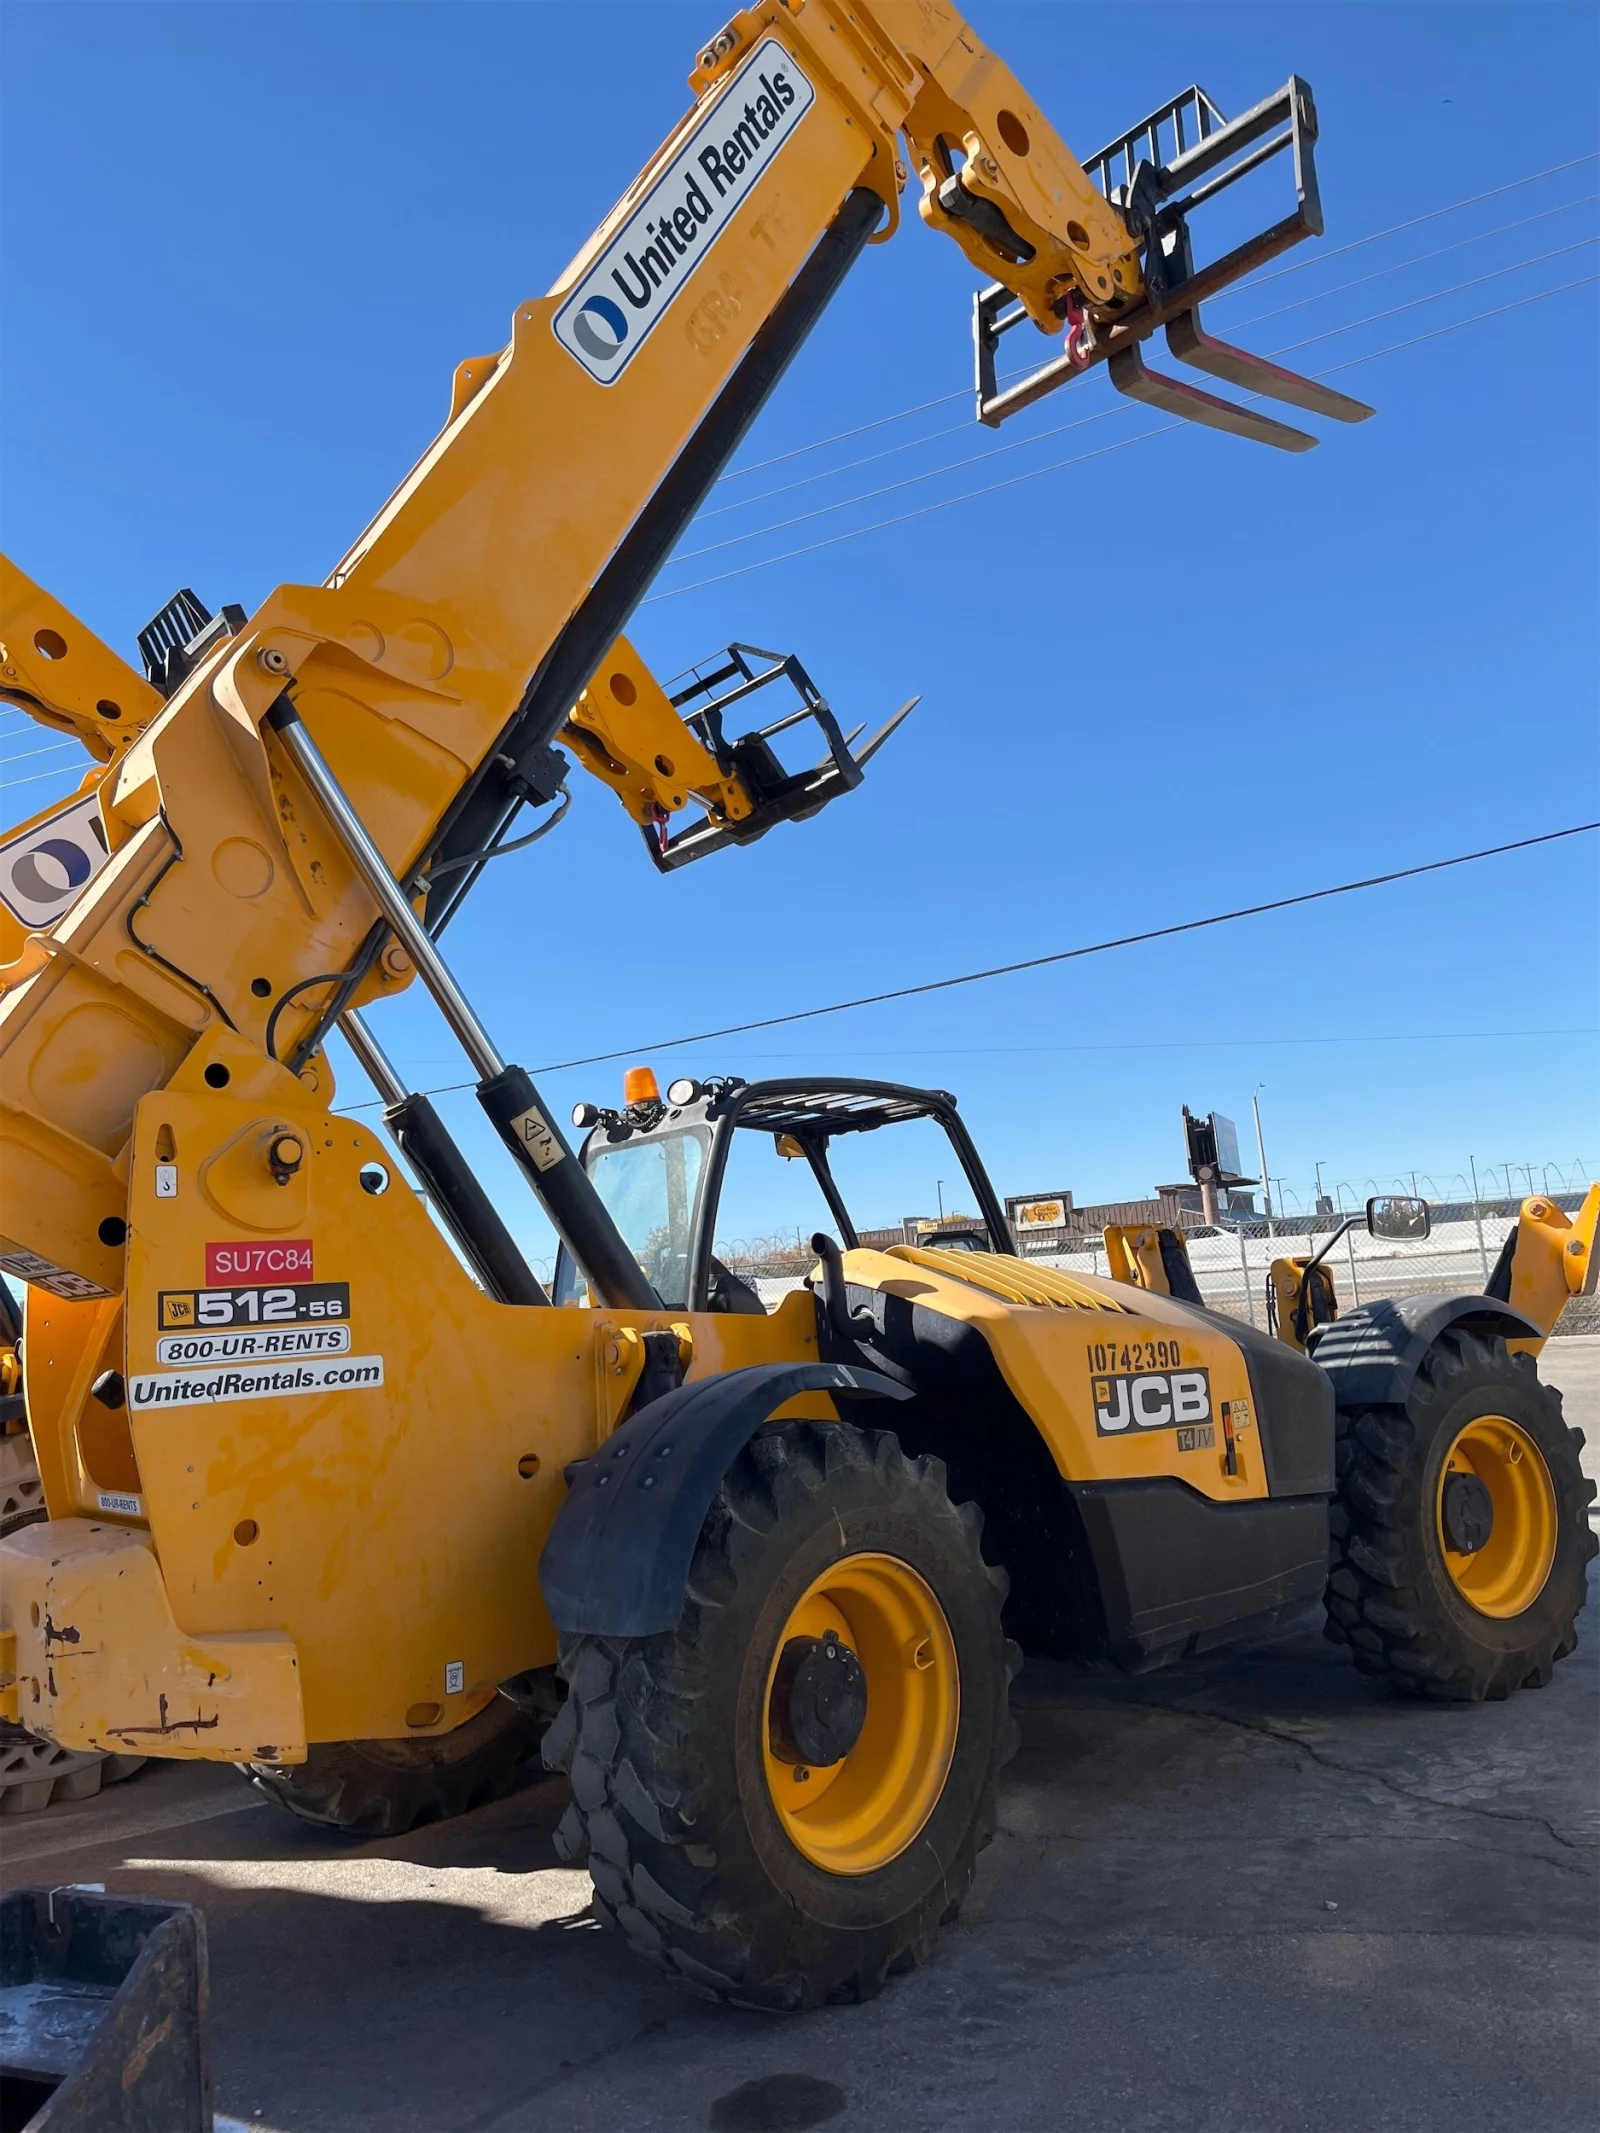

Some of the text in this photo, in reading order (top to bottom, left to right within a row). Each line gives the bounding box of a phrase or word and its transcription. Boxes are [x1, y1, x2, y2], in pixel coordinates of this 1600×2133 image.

[611, 72, 795, 309] United Rentals
[215, 1249, 313, 1273] SU7C84
[171, 1289, 343, 1325] JCB 512-56
[168, 1331, 341, 1360] 800-UR-RENTS
[1087, 1340, 1180, 1372] 10742390
[134, 1364, 379, 1403] UnitedRentals.com
[1098, 1373, 1209, 1430] JCB
